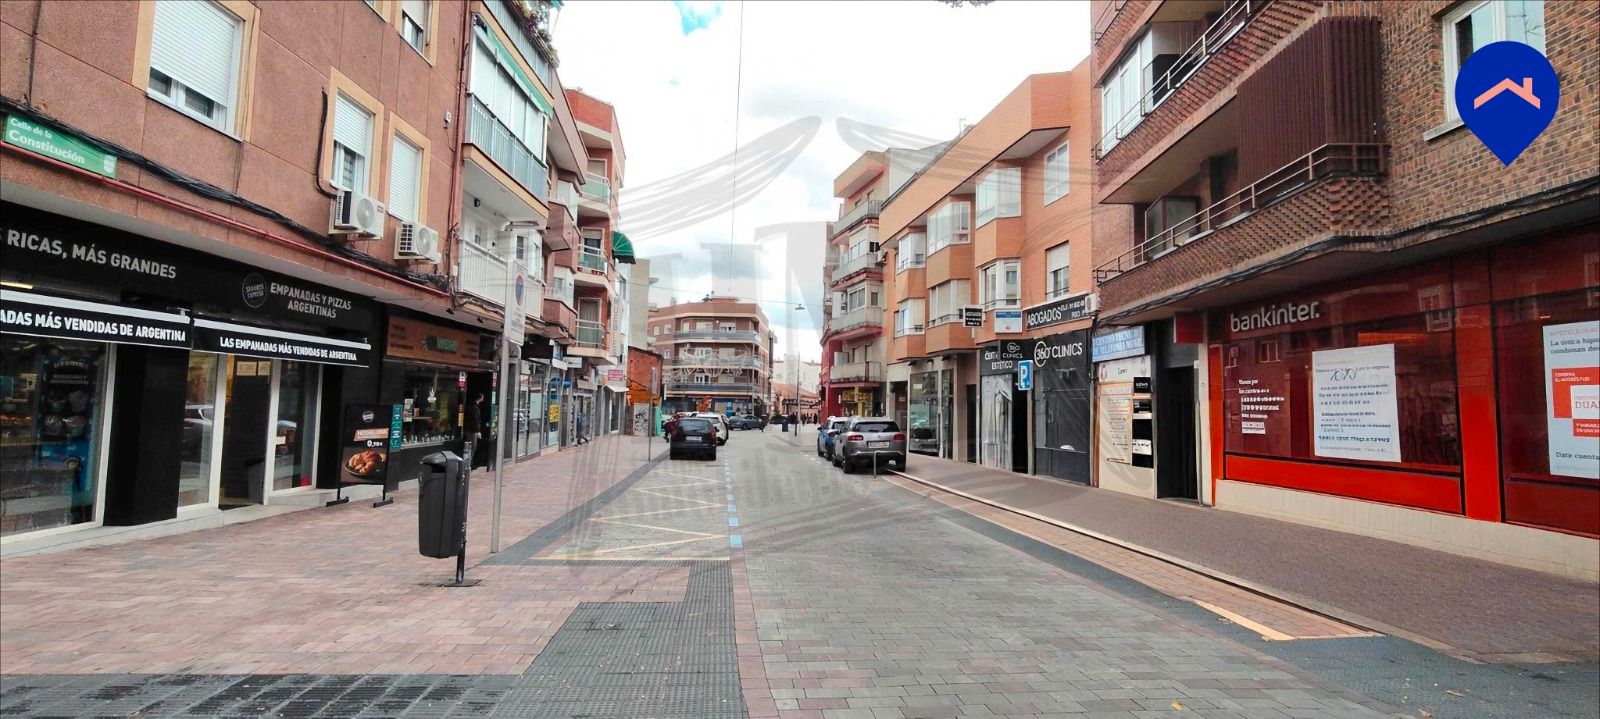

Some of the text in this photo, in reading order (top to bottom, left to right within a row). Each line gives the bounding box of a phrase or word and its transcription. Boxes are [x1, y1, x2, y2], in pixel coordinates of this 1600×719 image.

[10, 118, 53, 139] Calle de la
[9, 130, 85, 164] Constitución
[7, 229, 177, 279] RICAS, MÁS GRANDES
[270, 282, 352, 310] EMPANADAS Y PIZZAS
[288, 300, 337, 319] ARGENTINAS
[1027, 307, 1062, 326] ABOGADOS
[1230, 301, 1320, 332] bankinter.
[35, 311, 62, 329] MÁS
[64, 317, 118, 335] VENDIDAS
[120, 324, 134, 337] DE
[135, 325, 186, 342] ARGENTINA
[219, 336, 357, 361] LAS EMPANADAS MÁS VENDIDAS DE ARGENTINA
[1051, 342, 1083, 359] CLINICS
[1020, 365, 1028, 380] P
[1575, 401, 1598, 409] DUA
